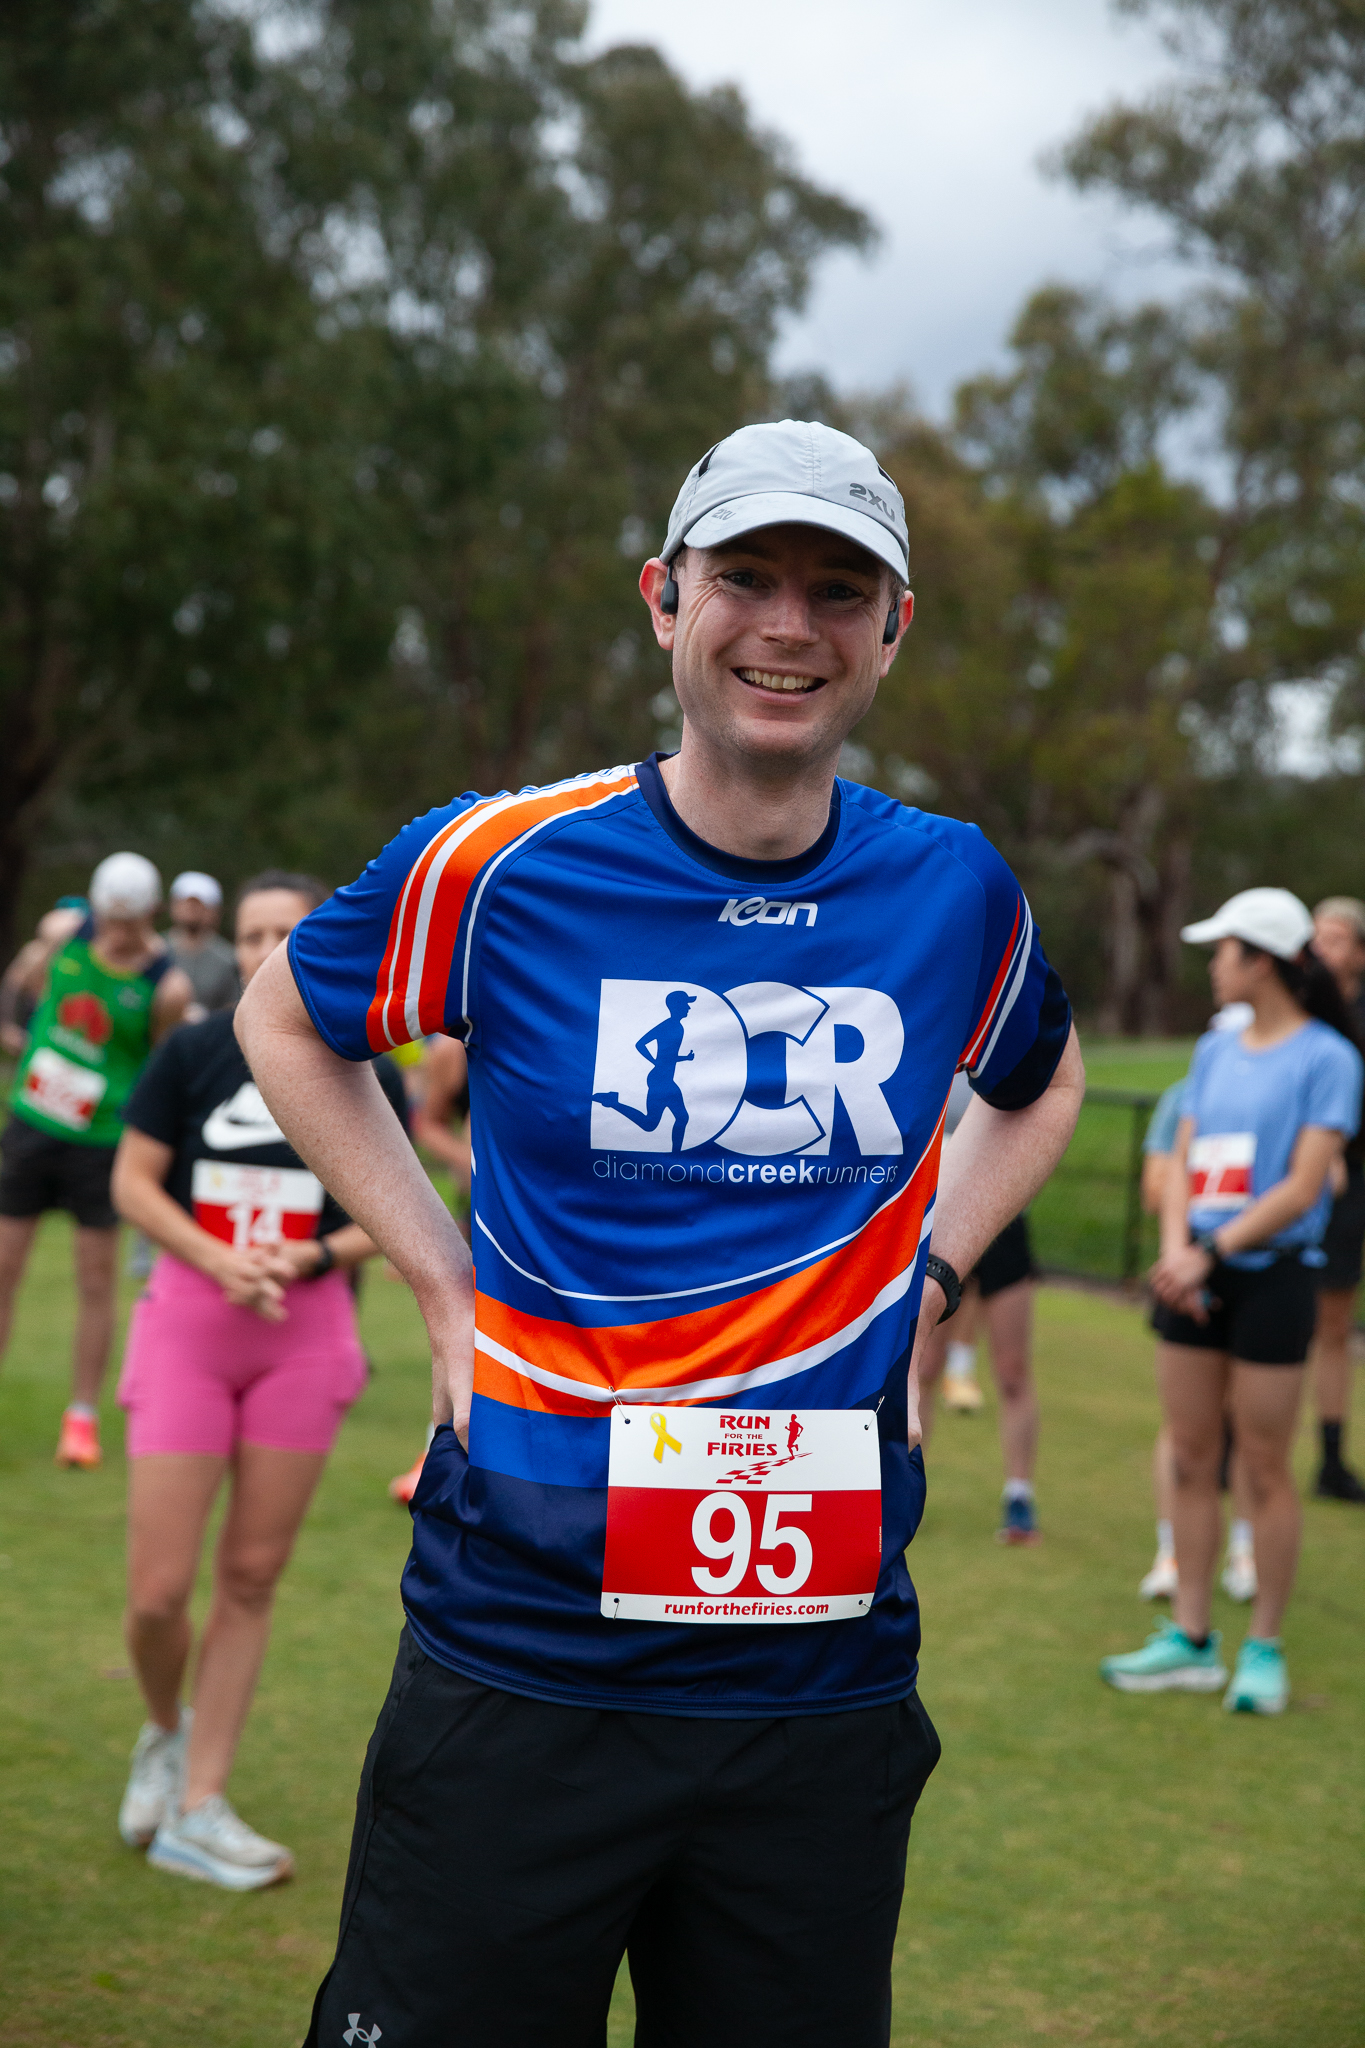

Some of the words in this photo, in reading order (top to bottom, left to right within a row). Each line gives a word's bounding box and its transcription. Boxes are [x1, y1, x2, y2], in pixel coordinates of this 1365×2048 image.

[849, 482, 895, 522] 2XU
[590, 978, 905, 1157] DCR
[593, 1154, 898, 1184] diamondcreekrunners
[719, 1414, 771, 1430] RUN
[707, 1441, 778, 1458] FIRIES
[691, 1491, 813, 1595] 95
[664, 1601, 829, 1616] runforthefiries.com
